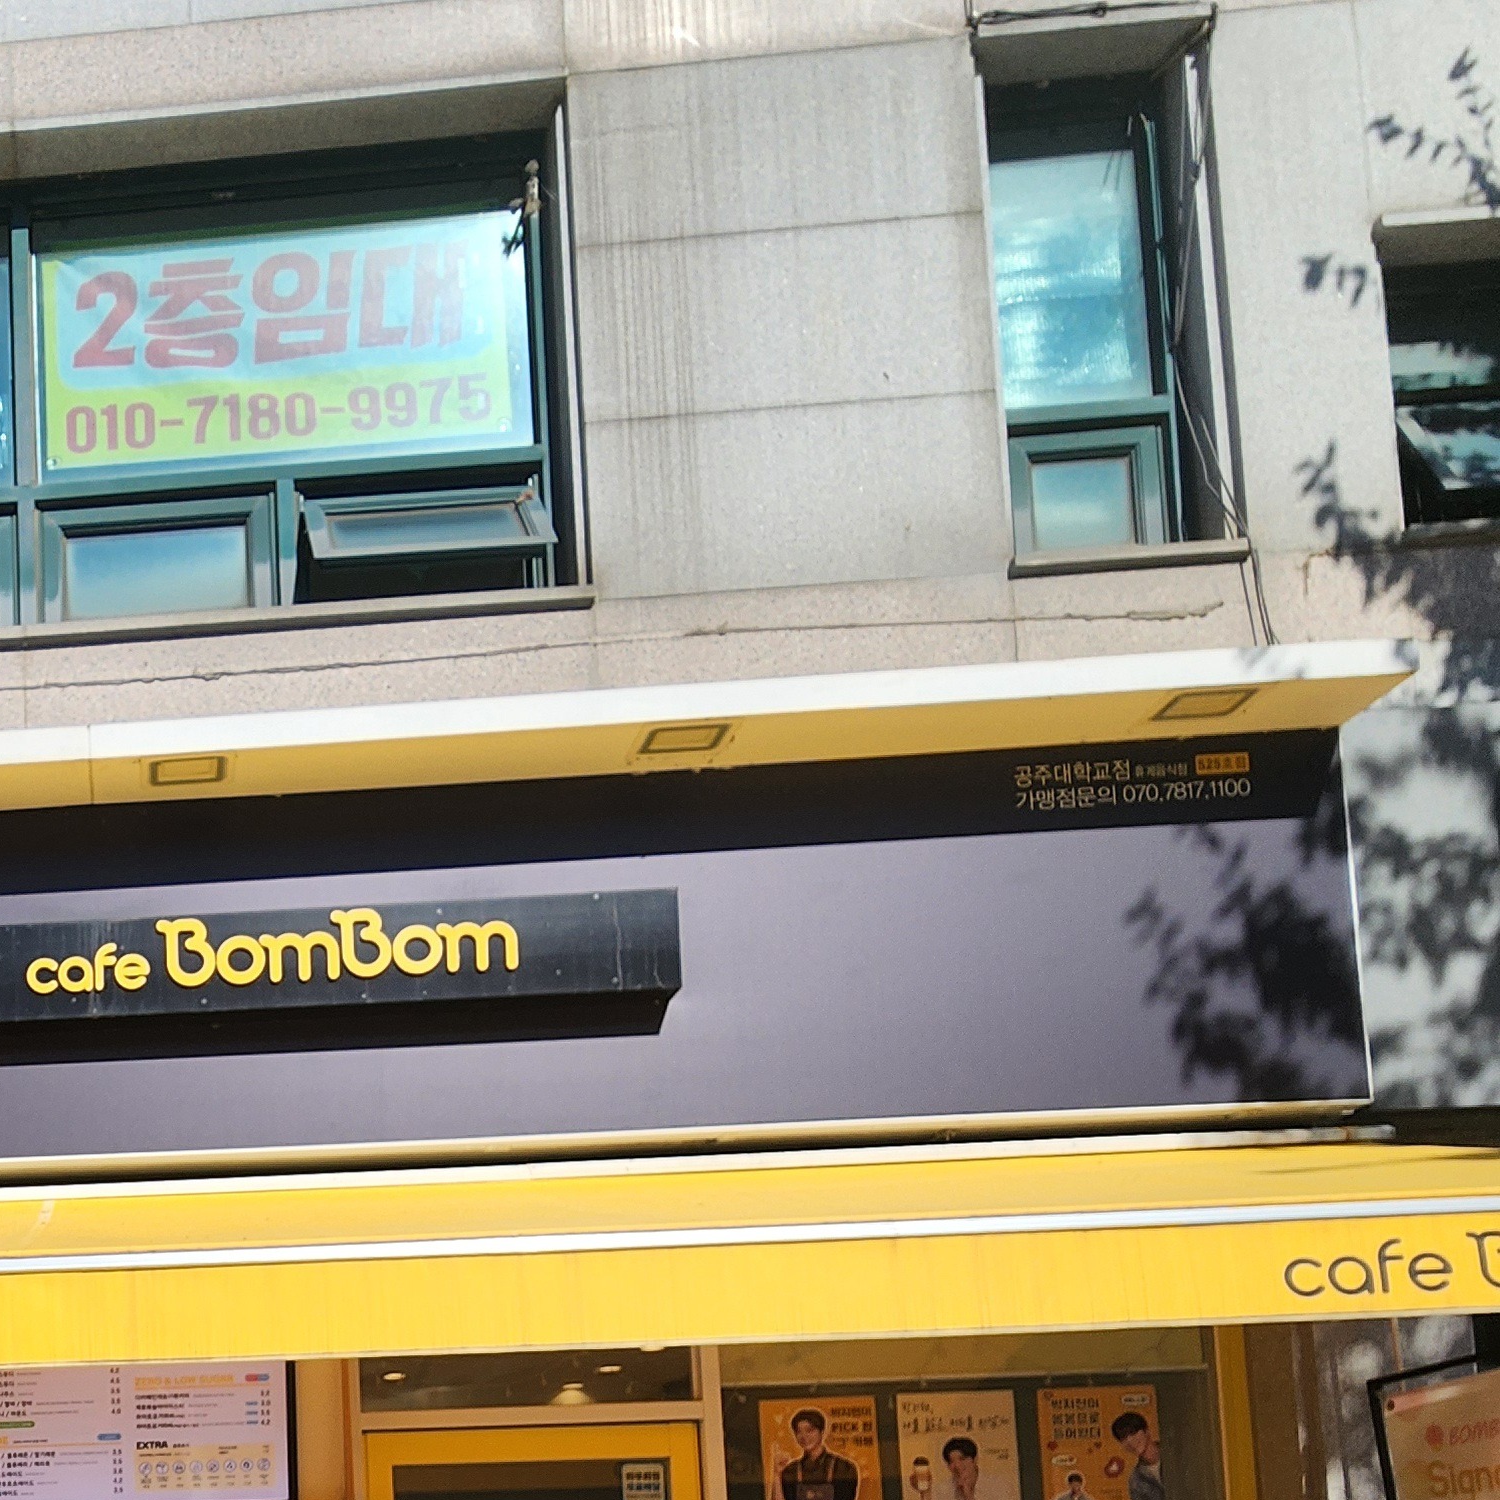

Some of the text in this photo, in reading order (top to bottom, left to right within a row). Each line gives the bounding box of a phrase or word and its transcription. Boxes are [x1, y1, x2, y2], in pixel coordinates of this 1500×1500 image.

[72, 240, 469, 371] 2층임대
[66, 373, 492, 453] 010-7180-9975
[1013, 759, 1130, 788] 공주대학교점
[1015, 778, 1251, 811] 가맹점문의 070.7817.1100
[26, 907, 520, 996] cafe BomBom
[1284, 1238, 1453, 1297] cafe
[136, 1441, 168, 1450] EXTRA
